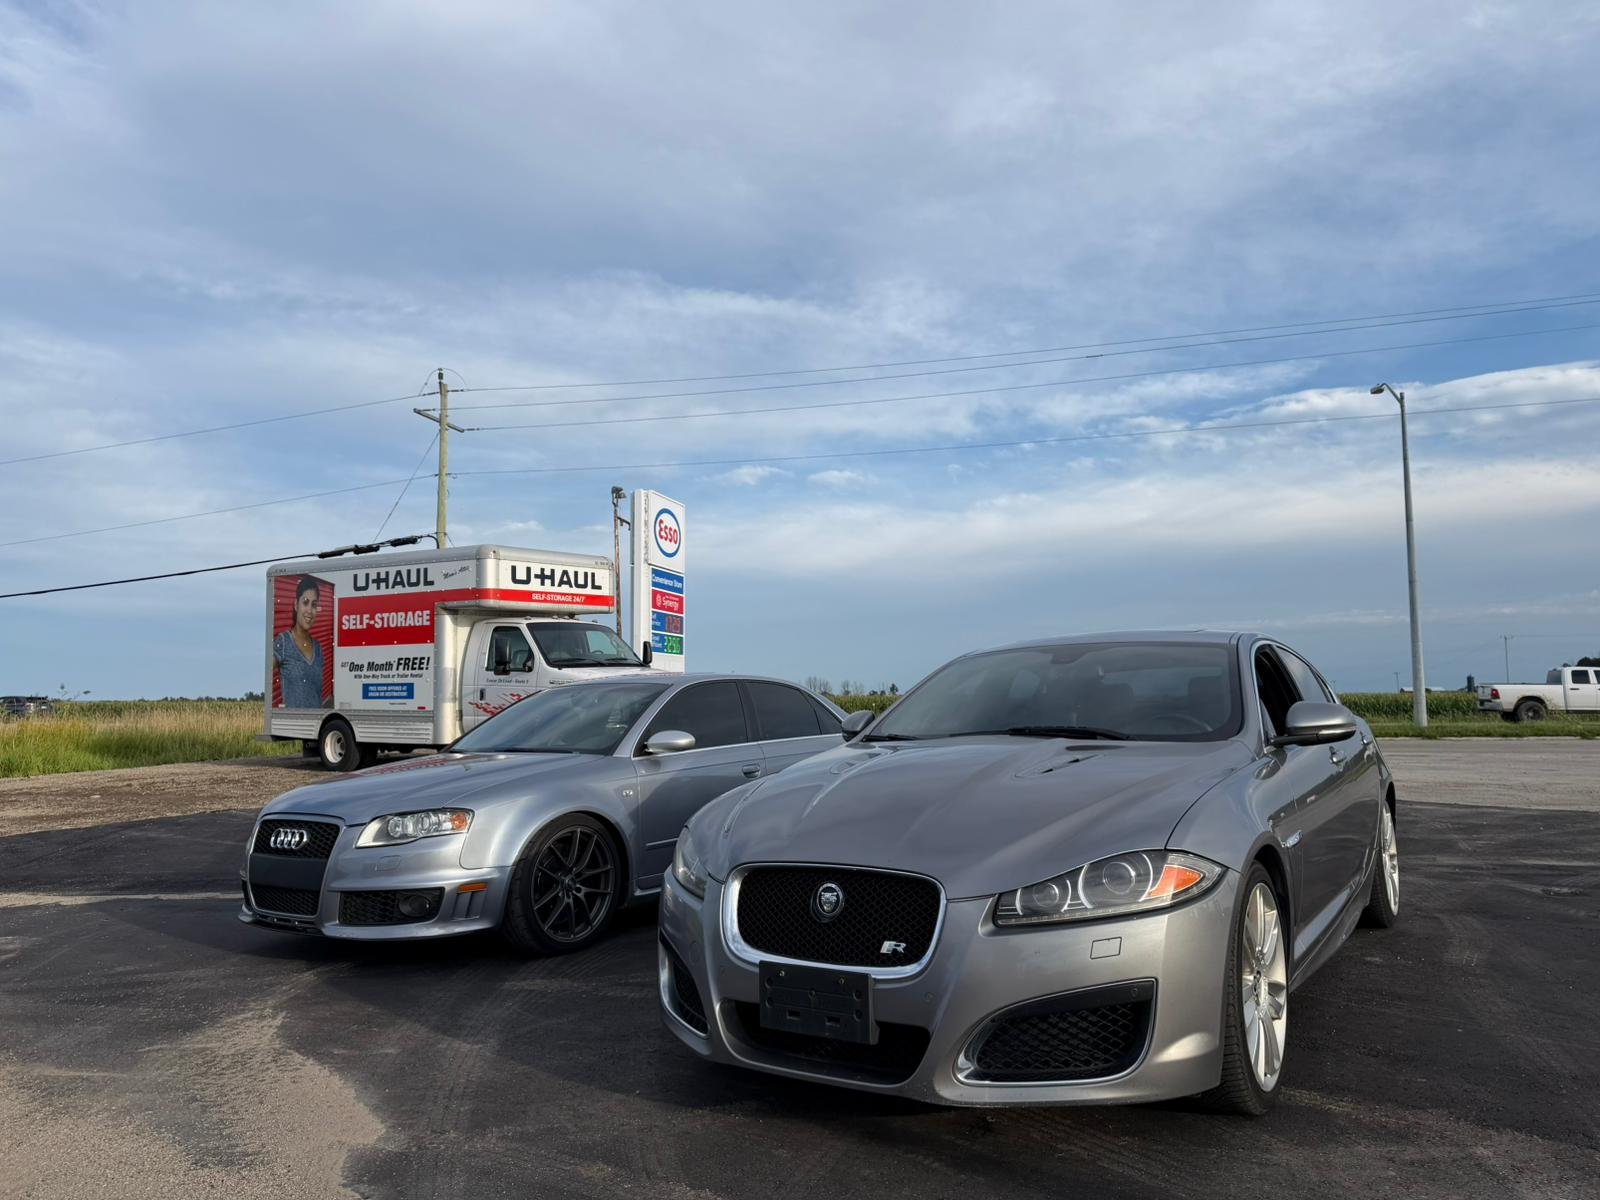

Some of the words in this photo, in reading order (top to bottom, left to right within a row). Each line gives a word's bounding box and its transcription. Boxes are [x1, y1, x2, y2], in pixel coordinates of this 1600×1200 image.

[658, 518, 678, 545] Esso
[353, 567, 435, 592] U-HAUL
[511, 565, 602, 590] U-HAUL
[531, 593, 572, 602] SELF-STORAGE
[341, 610, 431, 630] SELF-STORAGE
[349, 661, 365, 672] One
[396, 656, 431, 671] FREE!
